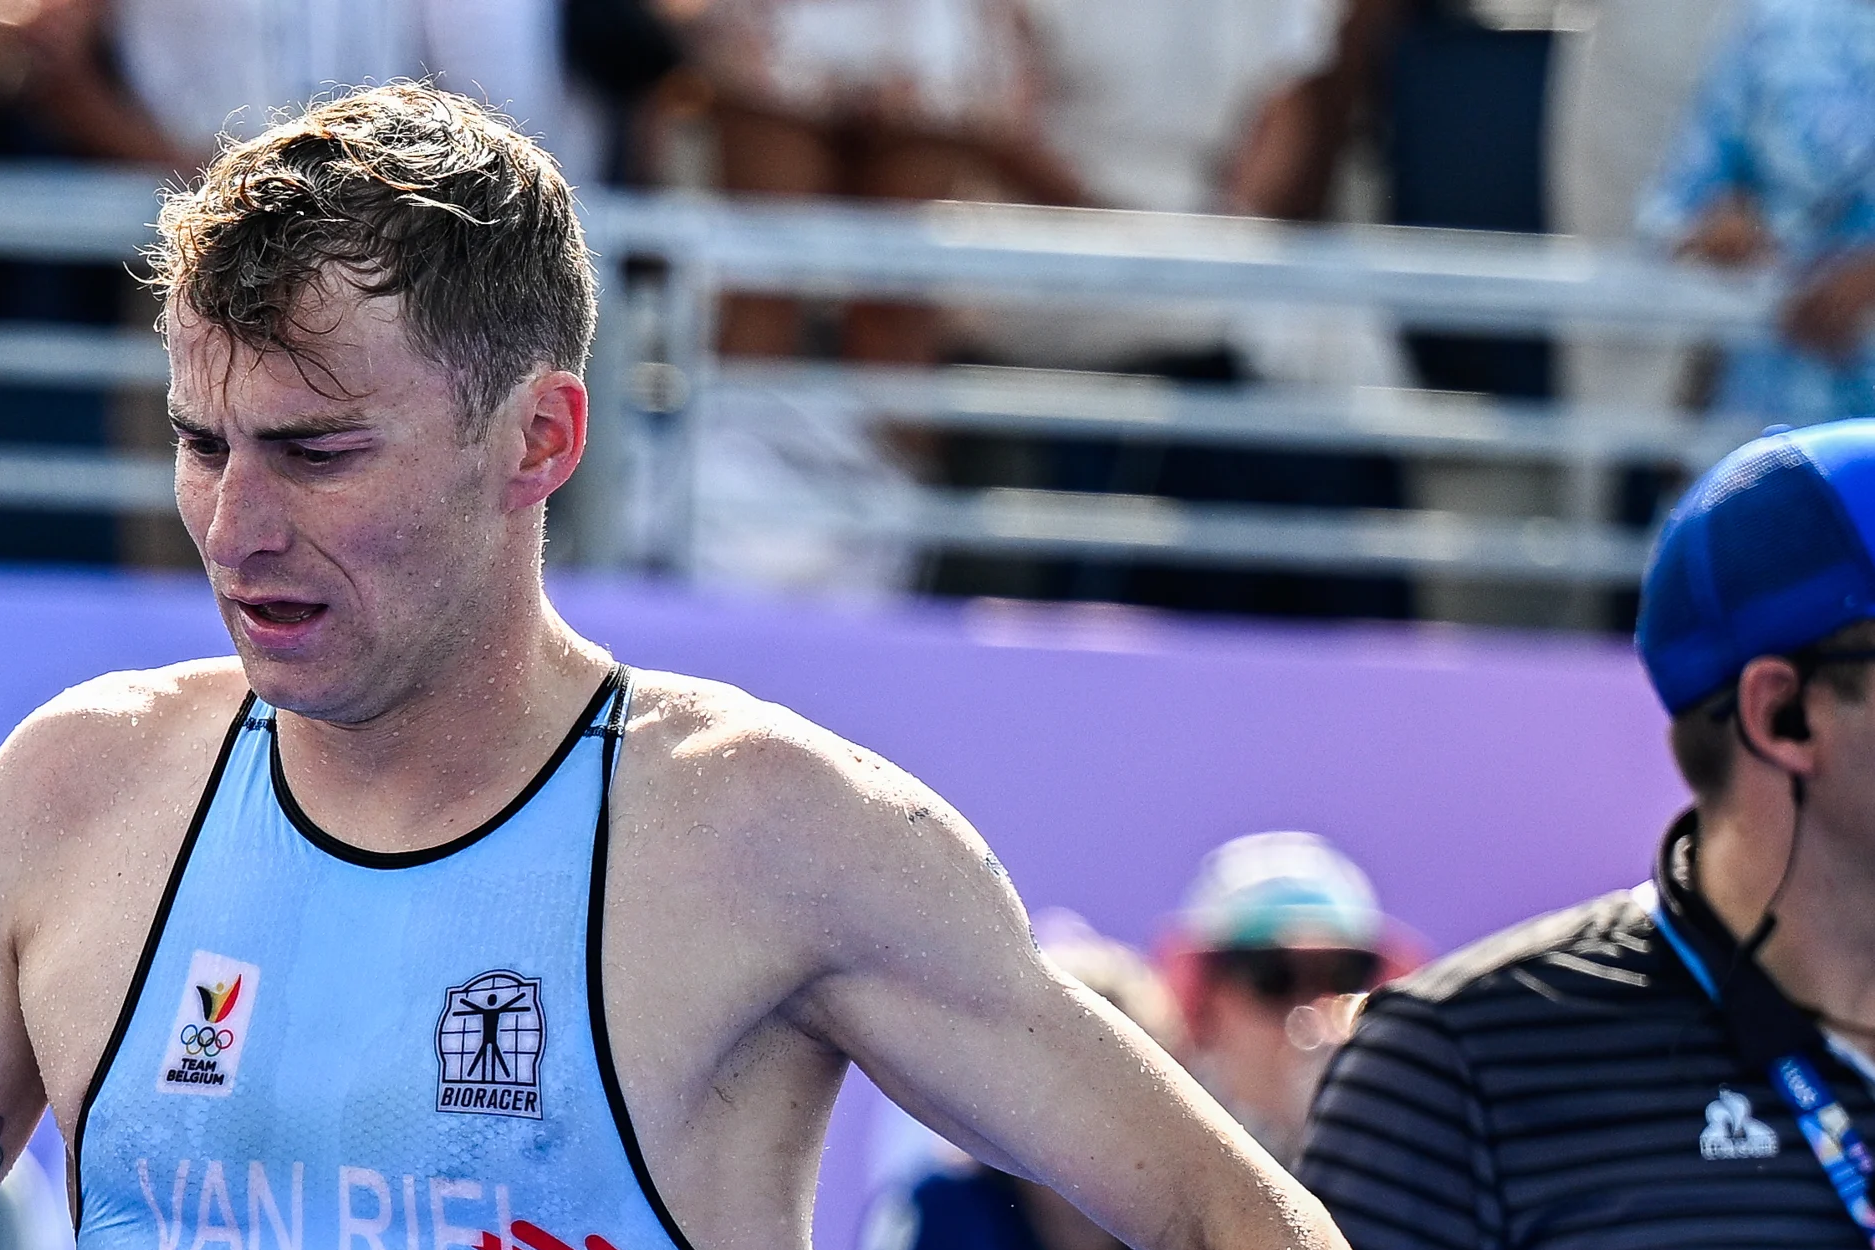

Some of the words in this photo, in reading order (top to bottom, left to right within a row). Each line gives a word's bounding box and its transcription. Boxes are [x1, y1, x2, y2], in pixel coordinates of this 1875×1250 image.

[181, 1057, 217, 1073] TEAM
[166, 1069, 225, 1086] BELGIUM
[440, 1087, 538, 1112] BIORACER
